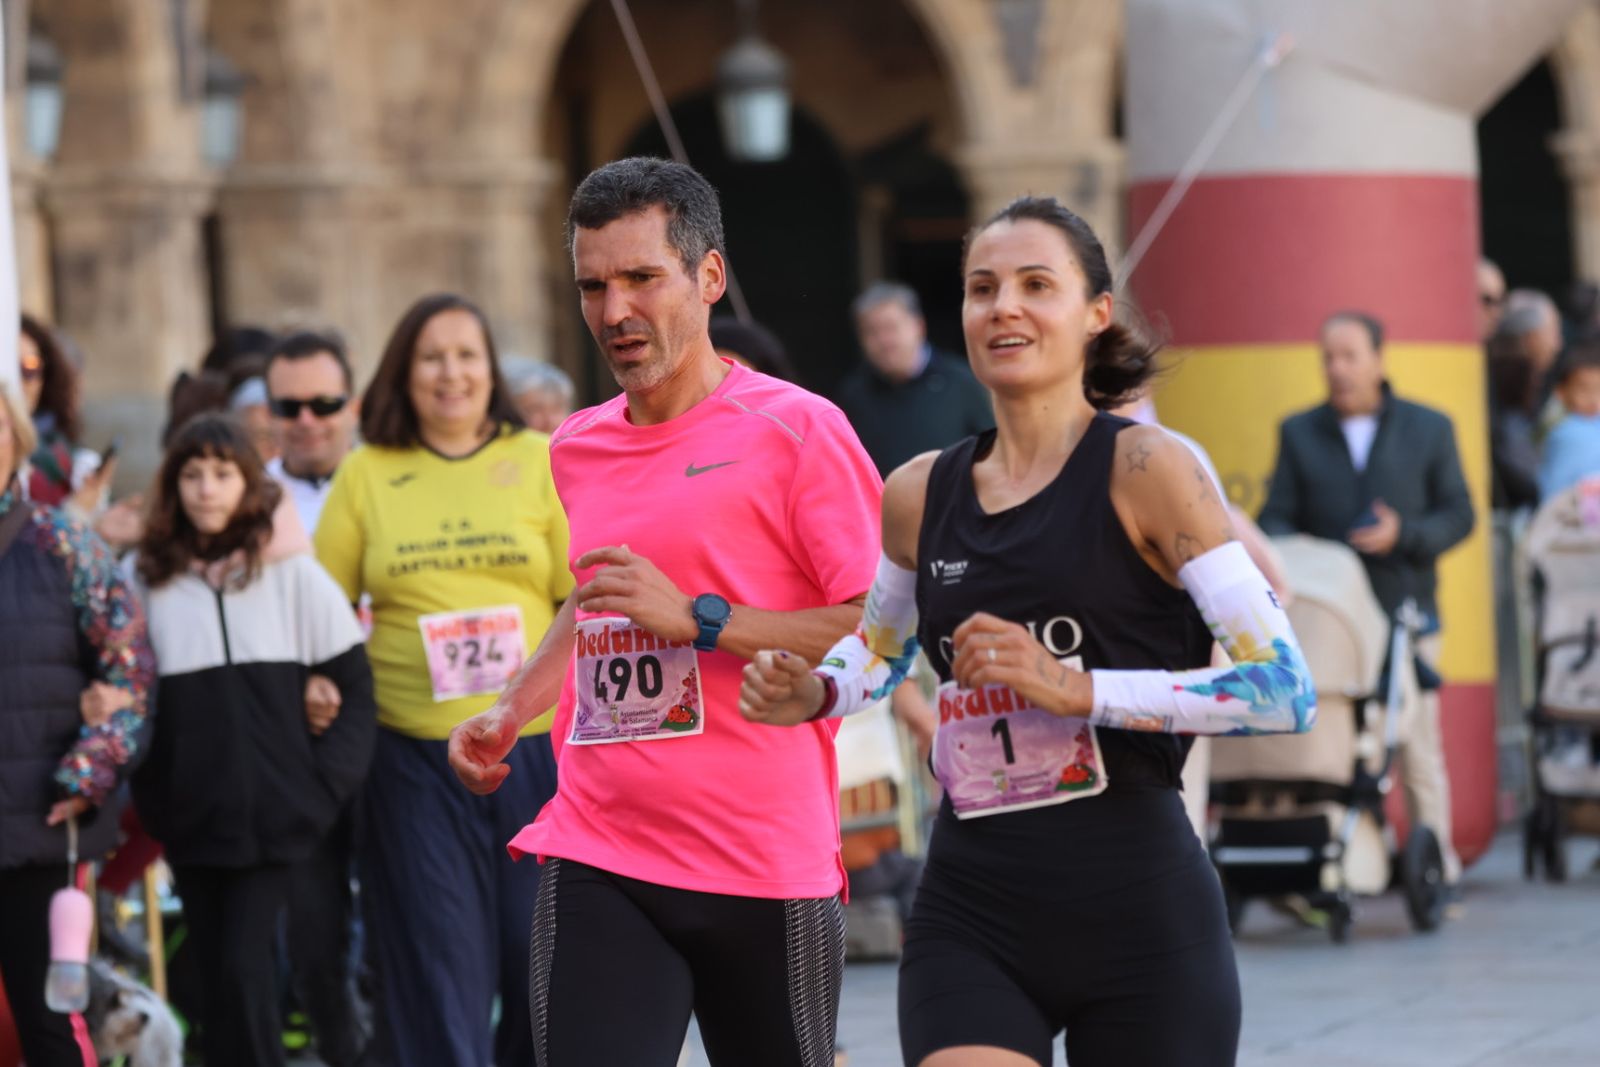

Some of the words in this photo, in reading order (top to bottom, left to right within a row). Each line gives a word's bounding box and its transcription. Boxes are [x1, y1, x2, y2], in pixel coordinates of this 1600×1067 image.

[387, 556, 466, 577] CASTILLA
[443, 635, 504, 670] 924
[577, 624, 692, 659] bedun
[594, 655, 663, 703] 490
[991, 718, 1014, 765] 1
